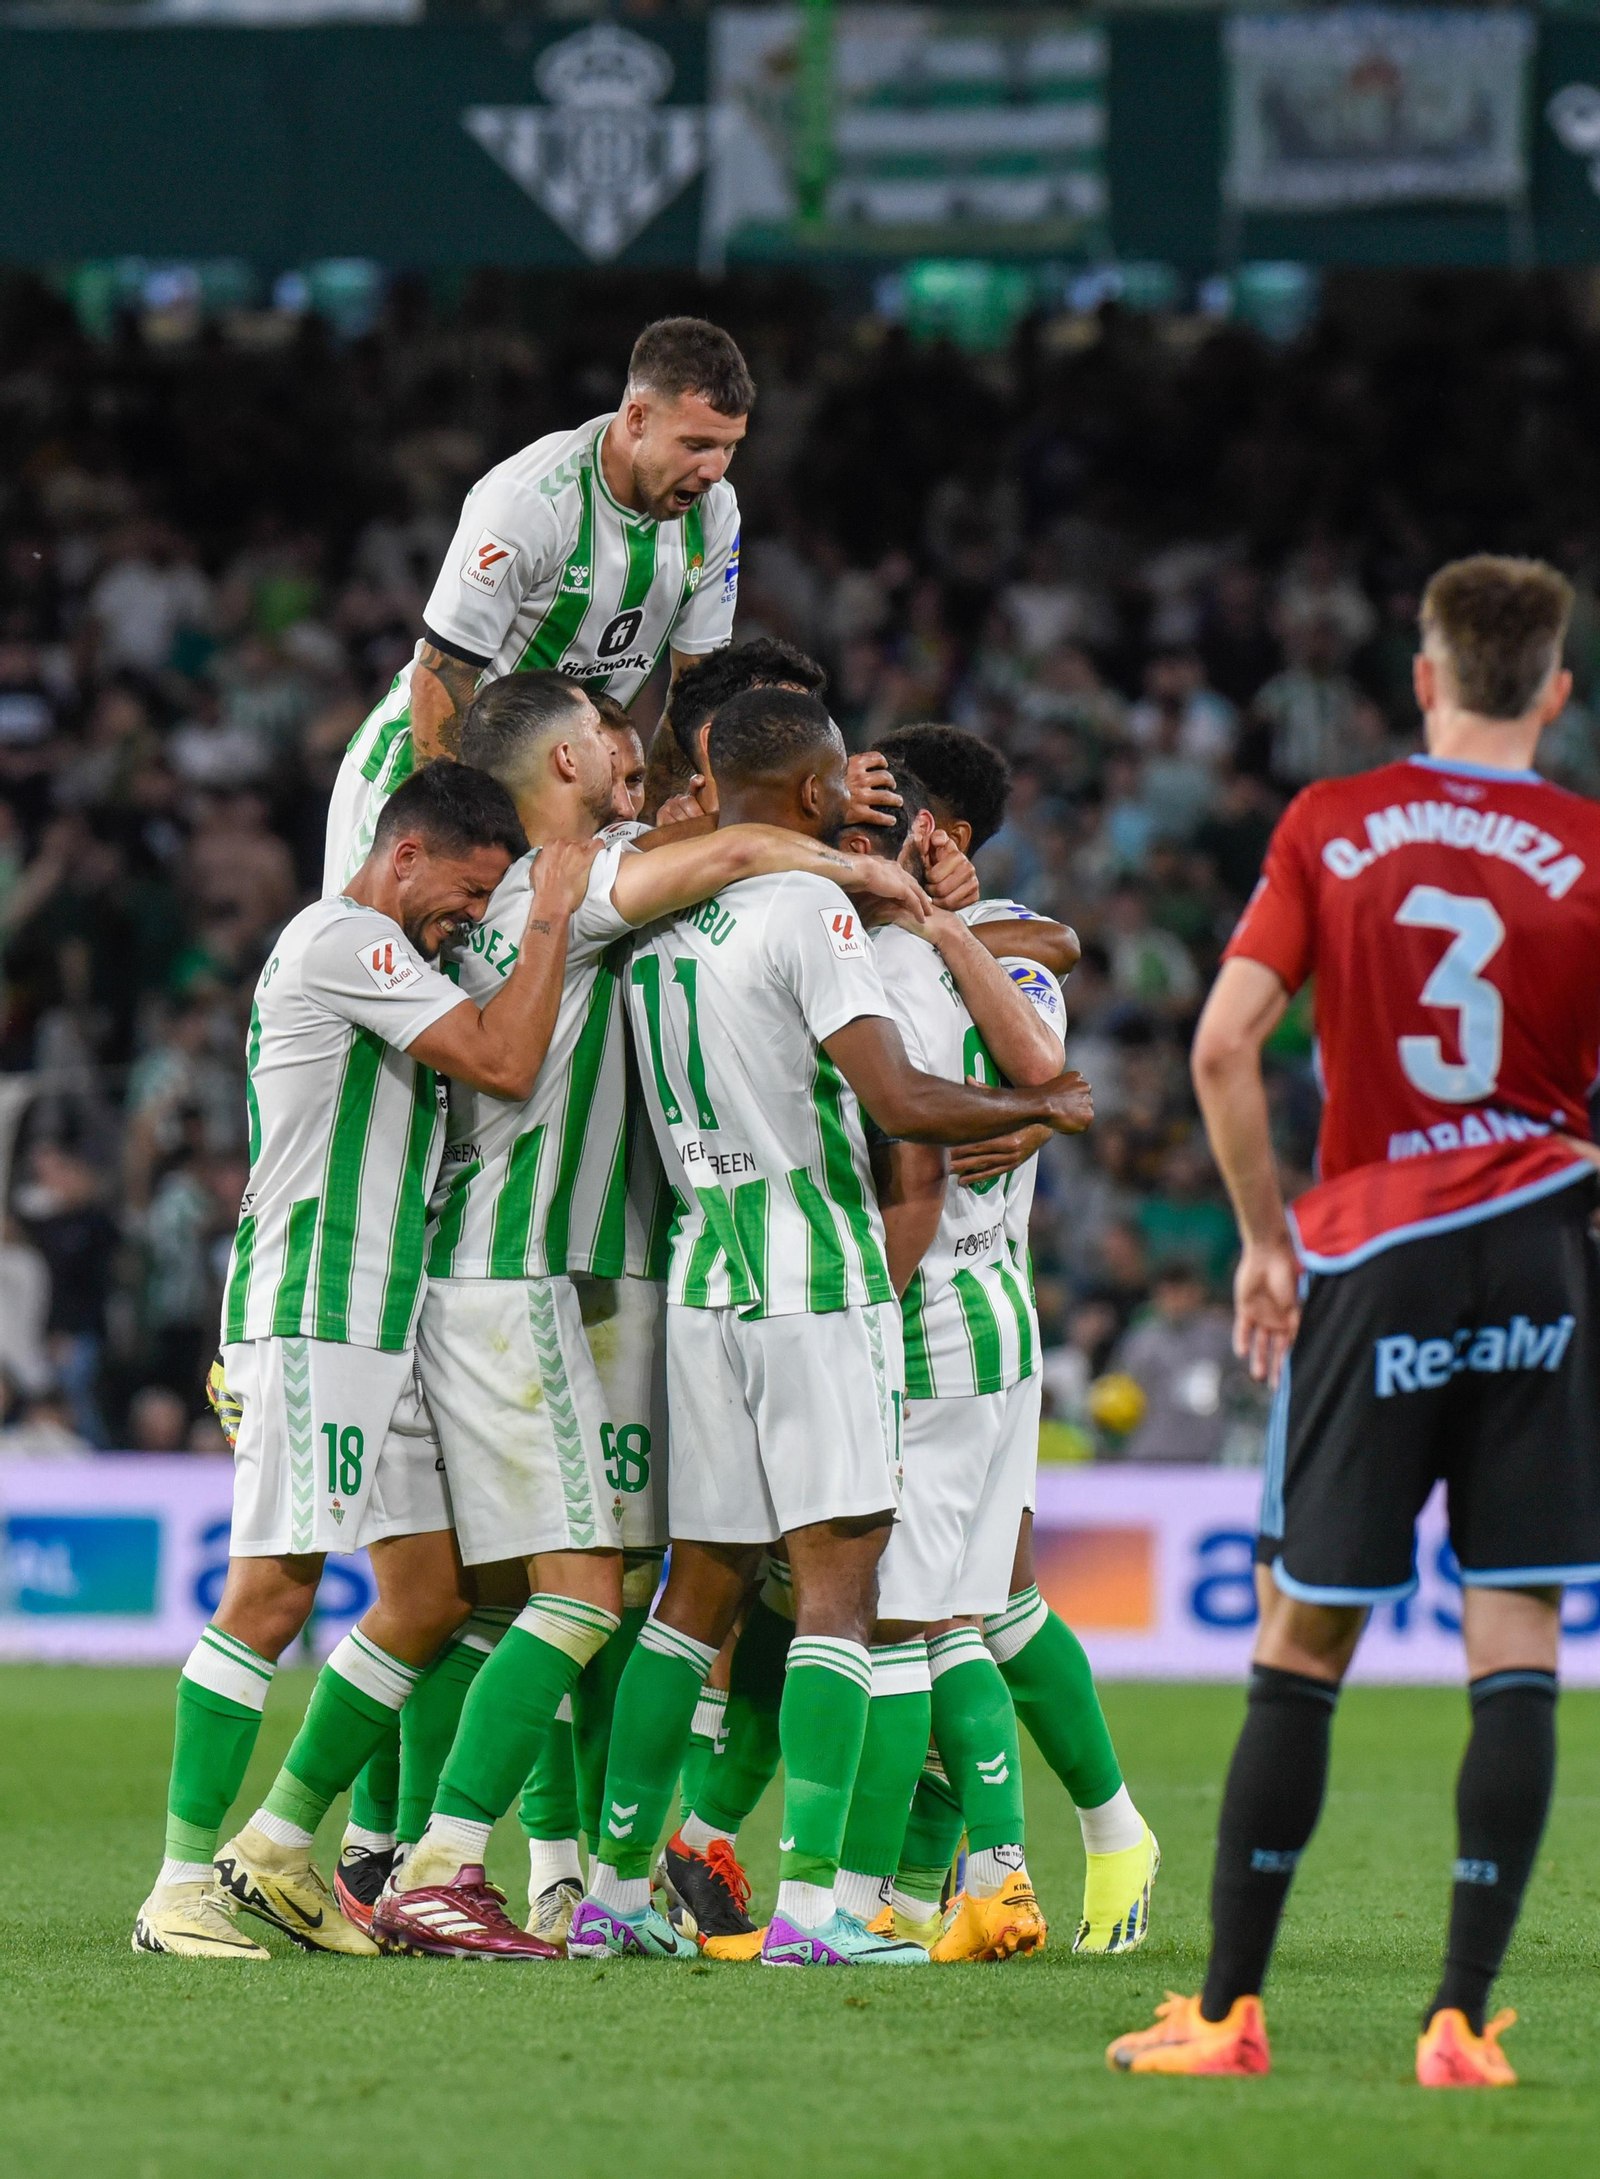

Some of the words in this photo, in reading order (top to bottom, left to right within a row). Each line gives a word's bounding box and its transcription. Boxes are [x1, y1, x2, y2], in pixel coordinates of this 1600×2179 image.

[466, 566, 496, 588] LALIGA
[1322, 800, 1586, 900] O.MINGUEZA
[384, 968, 413, 990] LALIGA
[1394, 885, 1505, 1104] 3
[632, 954, 720, 1130] 11
[321, 1423, 364, 1496] 18
